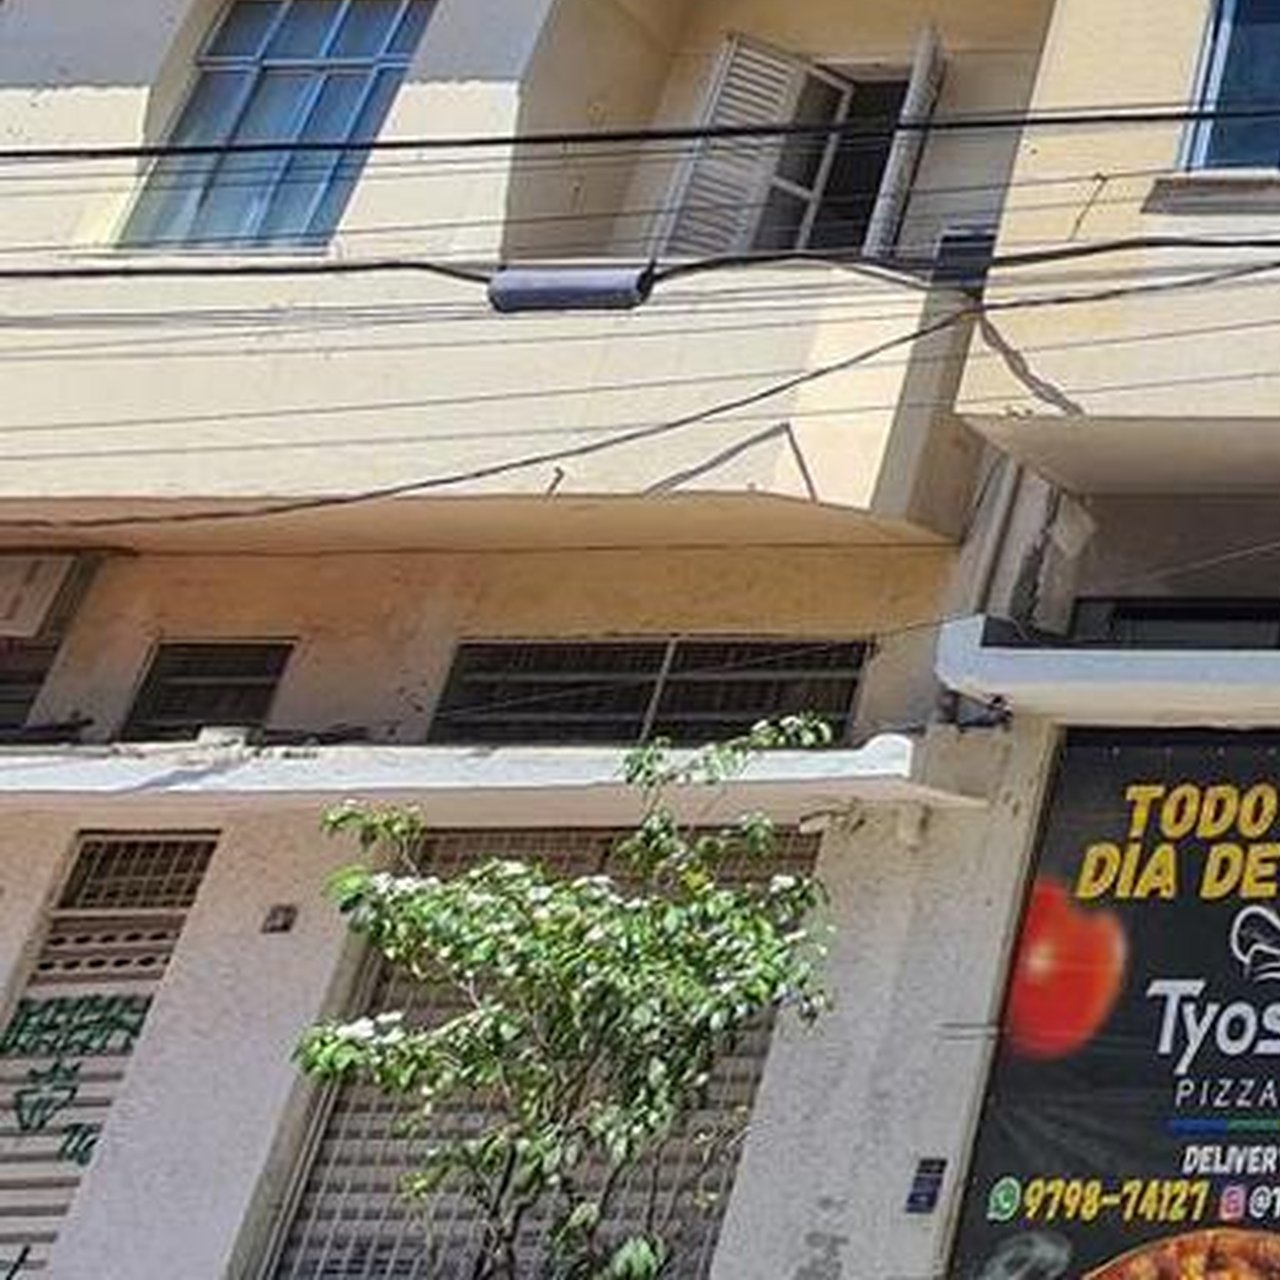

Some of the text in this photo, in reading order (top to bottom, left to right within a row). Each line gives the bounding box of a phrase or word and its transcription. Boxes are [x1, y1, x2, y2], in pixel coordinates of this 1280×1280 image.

[1126, 784, 1279, 839] TODO
[1076, 841, 1177, 899] DIA
[1022, 1177, 1211, 1221] 9798-74127
